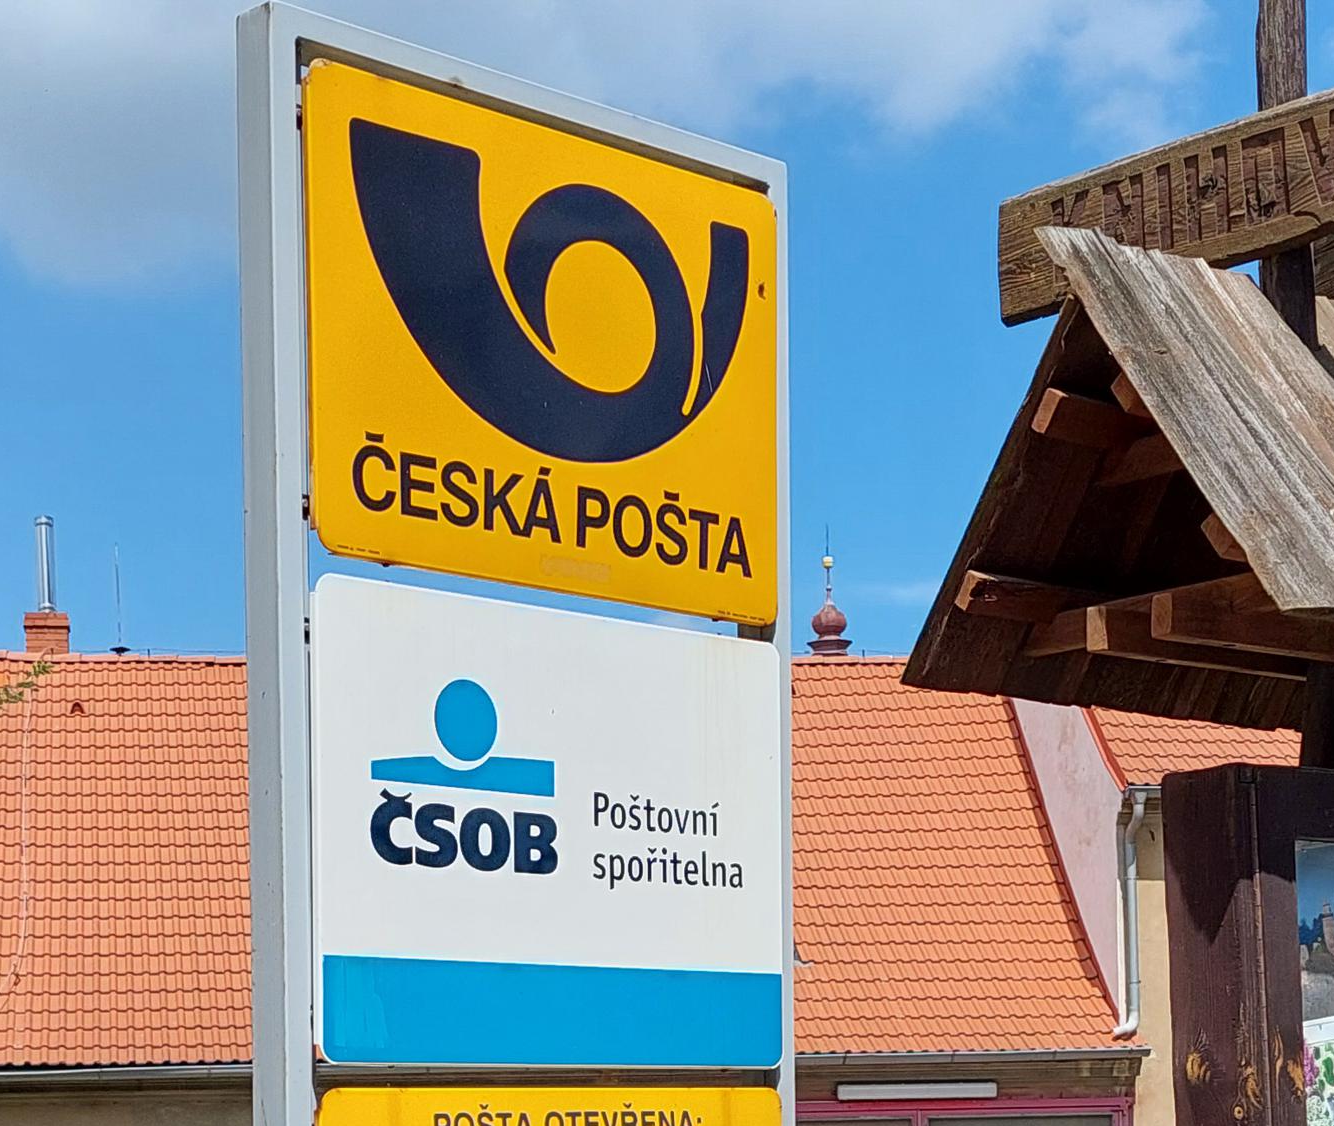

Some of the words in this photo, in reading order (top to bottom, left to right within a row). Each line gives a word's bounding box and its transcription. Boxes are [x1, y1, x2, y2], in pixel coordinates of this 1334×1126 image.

[351, 430, 562, 545] ČESKÁ
[576, 484, 753, 579] POŠTA
[370, 788, 558, 875] ČSOB
[593, 791, 720, 837] Poštovní
[592, 847, 744, 890] spořitelna
